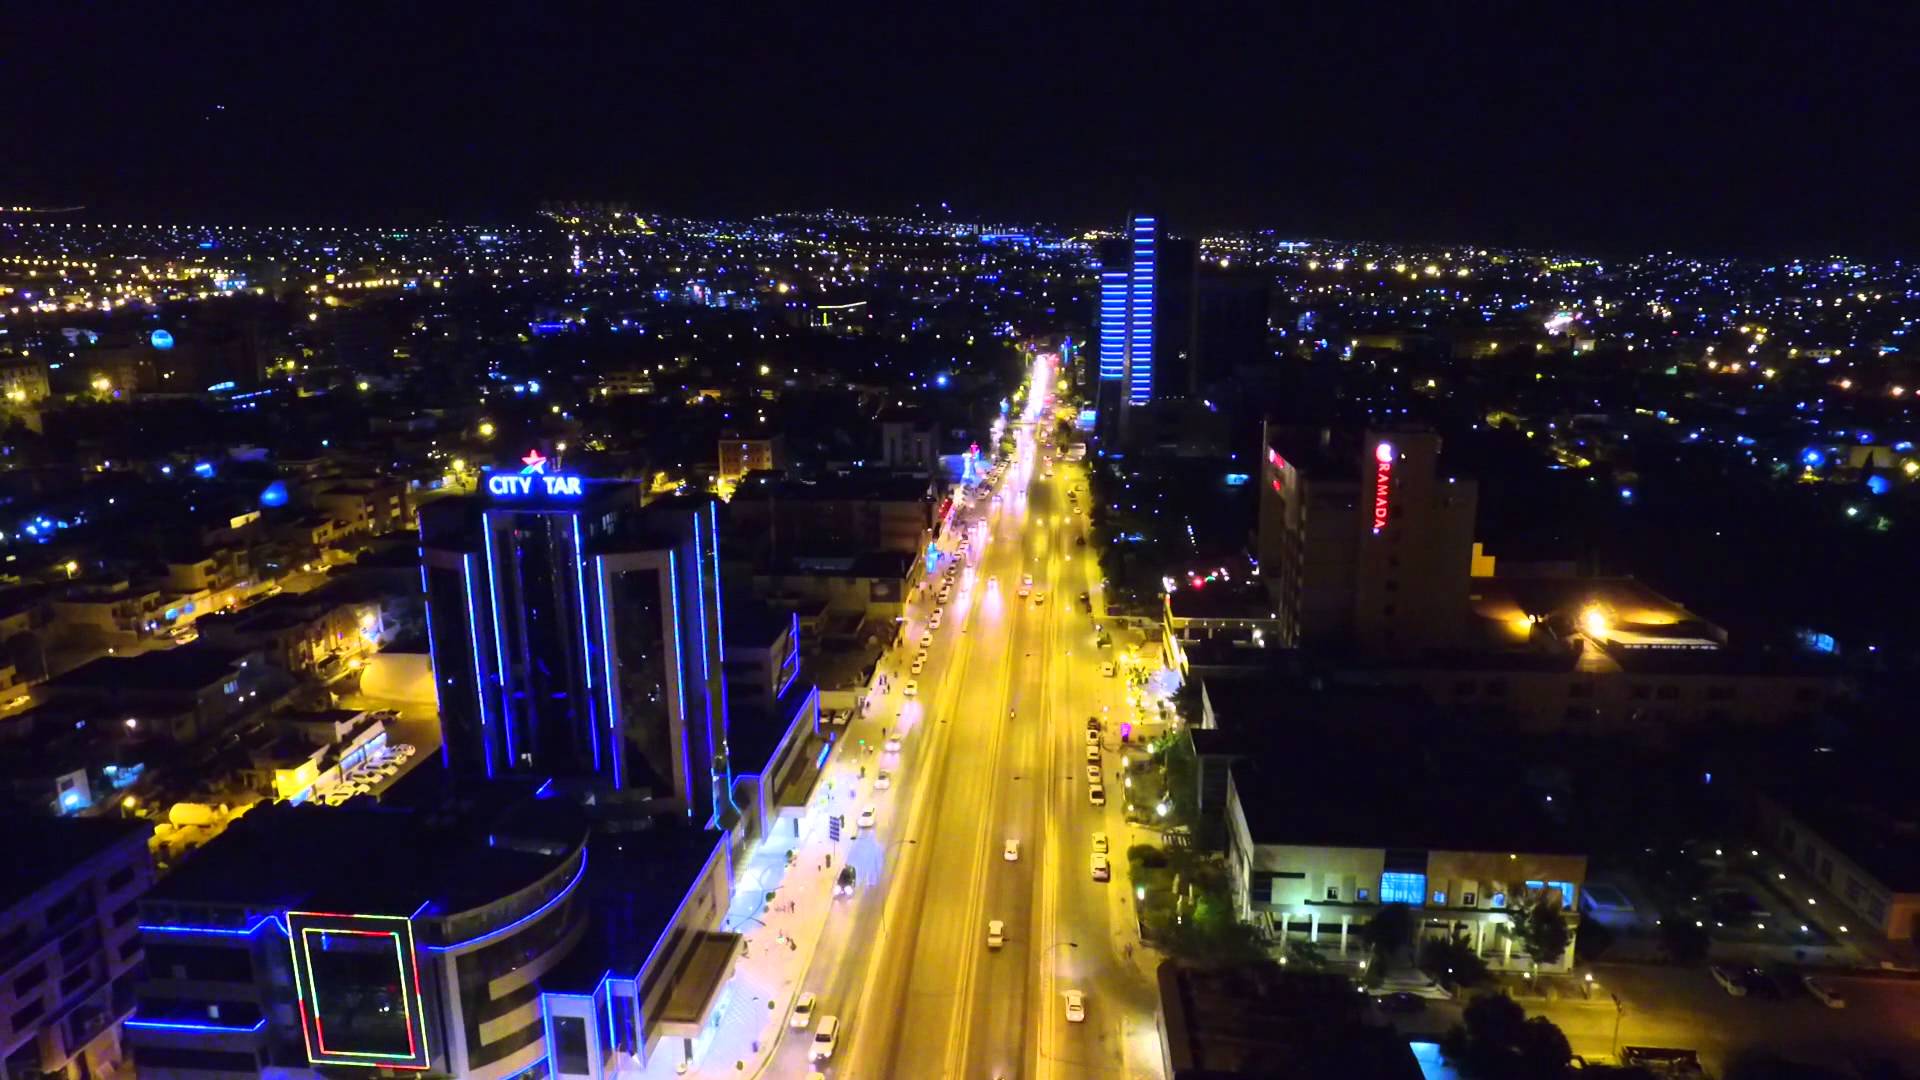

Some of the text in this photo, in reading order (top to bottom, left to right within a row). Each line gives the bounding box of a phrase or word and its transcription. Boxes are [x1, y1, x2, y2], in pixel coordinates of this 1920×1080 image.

[489, 476, 582, 495] CITY TAR
[1374, 463, 1391, 528] RAMADA
